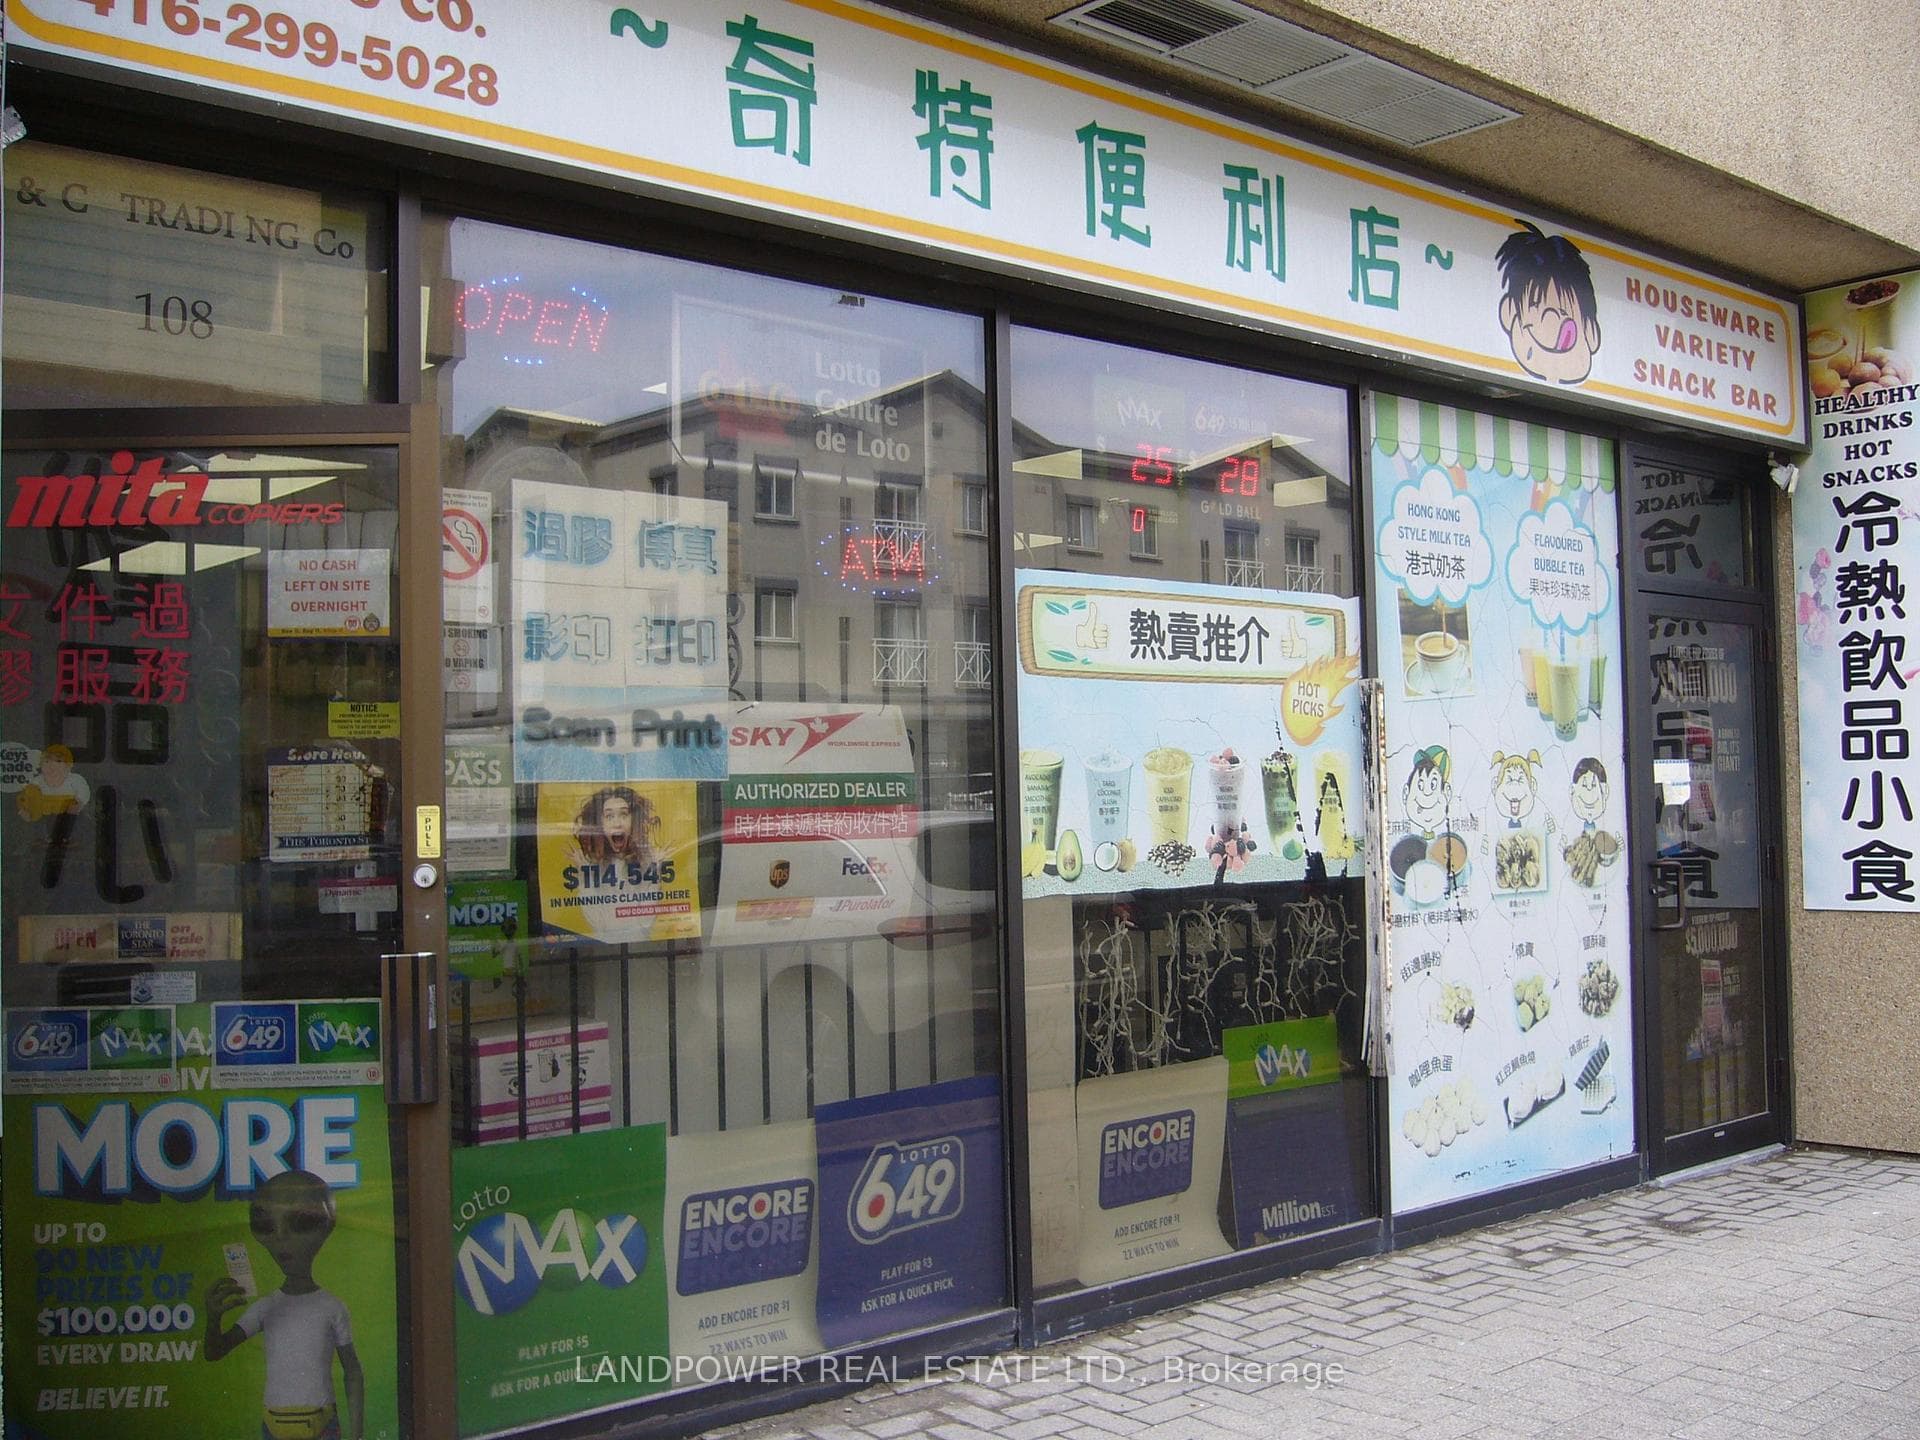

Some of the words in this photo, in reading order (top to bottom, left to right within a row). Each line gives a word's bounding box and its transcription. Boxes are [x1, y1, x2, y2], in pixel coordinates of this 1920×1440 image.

[16, 177, 46, 207] &
[62, 184, 88, 213] C
[134, 293, 214, 339] 108
[456, 286, 608, 352] OPEN
[1626, 277, 1776, 343] HOUSEWARE
[1655, 325, 1756, 371] VARIETY
[815, 351, 881, 387] Lotto
[1633, 358, 1716, 399] SNACK
[1731, 384, 1777, 416] BAR
[1815, 384, 1920, 415] HEALTHY
[815, 390, 899, 427] Centre
[1823, 411, 1913, 439] DRINKS
[816, 424, 846, 453] de
[858, 430, 911, 463] Loto
[1844, 439, 1892, 461] HOT
[1131, 444, 1174, 485] 25
[1219, 456, 1261, 496] 28
[1823, 462, 1918, 488] SNACKS
[7, 450, 209, 528] mita
[207, 503, 344, 525] COPIERS
[1408, 504, 1433, 518] HONG
[1435, 507, 1460, 522] KONG
[1398, 526, 1428, 542] STYLE
[1429, 529, 1452, 545] MILK
[1453, 532, 1471, 548] TEA
[1534, 534, 1584, 553] FLAVOURED
[299, 559, 317, 571] NO
[321, 559, 357, 571] CASH
[841, 539, 923, 582] ATM
[1405, 550, 1466, 580] 港式奶茶
[1534, 558, 1567, 575] BUBBLE
[1569, 560, 1586, 576] TEA
[285, 580, 317, 592] LEFT
[319, 580, 340, 592] ON
[342, 580, 371, 592] SITE
[291, 600, 368, 613] OVERNIGHT
[1129, 607, 1270, 665] 熱賣推介
[1297, 680, 1321, 699] HOT
[1832, 490, 1915, 903] 冷熱飲品小食
[350, 703, 379, 714] NOTICE
[1292, 699, 1324, 718] PICKS
[523, 707, 617, 748] Scan
[632, 709, 722, 748] Print
[729, 727, 797, 747] SKY
[735, 783, 840, 800] AUTHORIZED
[844, 782, 906, 799] DEALER
[562, 860, 676, 892] $114,545
[550, 898, 562, 908] IN
[563, 894, 618, 908] WINNINGS
[619, 890, 664, 904] CLAIMED
[665, 889, 690, 900] HERE
[617, 908, 631, 916] YOU
[632, 907, 652, 915] COULD
[450, 902, 518, 926] MORE
[170, 925, 189, 935] on
[223, 1022, 279, 1054] 649
[308, 1020, 373, 1052] MAX
[1254, 1043, 1308, 1087] MAX
[34, 1096, 361, 1193] MORE
[1105, 1115, 1191, 1155] ENCORE
[900, 1143, 951, 1163] LOTTO
[1103, 1139, 1190, 1180] ENCORE
[856, 1153, 956, 1232] 649
[454, 1185, 511, 1233] Lotto
[687, 1186, 809, 1230] ENCORE
[1262, 1200, 1321, 1231] Million
[34, 1223, 58, 1244] UP
[73, 1222, 108, 1243] TO
[684, 1216, 807, 1259] ENCORE
[1114, 1225, 1130, 1239] ADD
[1130, 1220, 1158, 1237] ENCORE
[1159, 1216, 1173, 1230] FOR
[88, 1245, 165, 1272] NEW
[458, 1207, 638, 1315] MAX
[1134, 1242, 1155, 1258] WAYS
[1155, 1241, 1166, 1253] TO
[881, 1265, 903, 1281] PLAY
[904, 1262, 922, 1276] FOR
[922, 1257, 934, 1271] $3
[36, 1273, 146, 1302] PRIZES
[152, 1272, 194, 1301] OF
[861, 1299, 878, 1314] ASK
[880, 1294, 897, 1309] FOR
[899, 1292, 906, 1305] A
[906, 1285, 933, 1300] QUICK
[934, 1278, 954, 1294] PICK
[37, 1303, 197, 1336] $100,000
[698, 1315, 719, 1331] ADD
[721, 1306, 759, 1327] ENCORE
[761, 1303, 781, 1317] FOR
[37, 1342, 114, 1367] EVERY
[120, 1340, 201, 1363] DRAW
[518, 1345, 548, 1362] PLAY
[551, 1339, 574, 1354] FOR
[576, 1335, 590, 1350] $5
[724, 1337, 752, 1355] WAYS
[754, 1335, 767, 1346] TO
[769, 1329, 789, 1343] WIN
[491, 1383, 515, 1398] ASK
[517, 1376, 541, 1391] FOR
[543, 1373, 551, 1387] A
[554, 1366, 589, 1384] QUICK
[36, 1386, 141, 1413] BELIEVE
[143, 1385, 171, 1409] IT.
